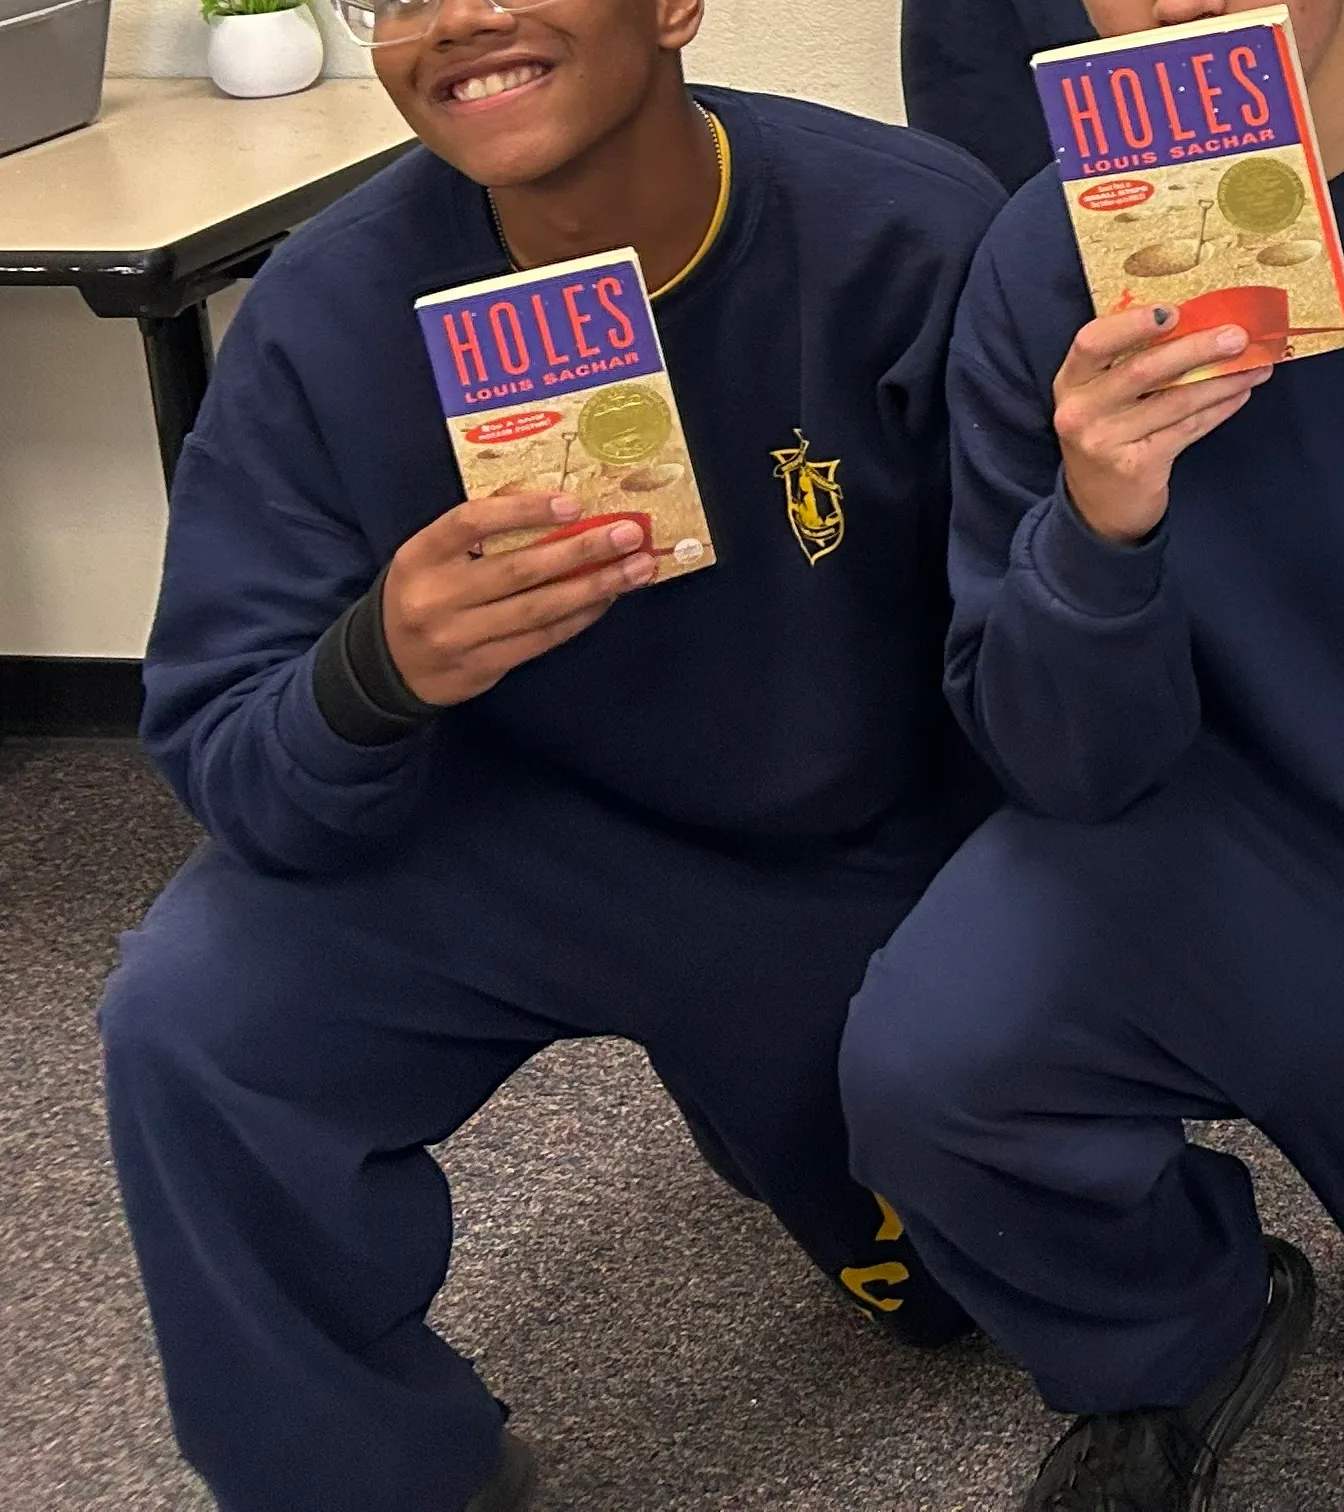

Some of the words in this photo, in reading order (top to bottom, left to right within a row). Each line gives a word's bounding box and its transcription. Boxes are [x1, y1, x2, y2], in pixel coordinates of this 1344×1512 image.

[1061, 46, 1270, 158] HOLES
[1081, 150, 1158, 174] LOUIS
[1168, 127, 1276, 159] SACHAR
[443, 276, 635, 387] HOLES
[465, 378, 535, 404] LOUIS
[542, 352, 640, 386] SACHAR
